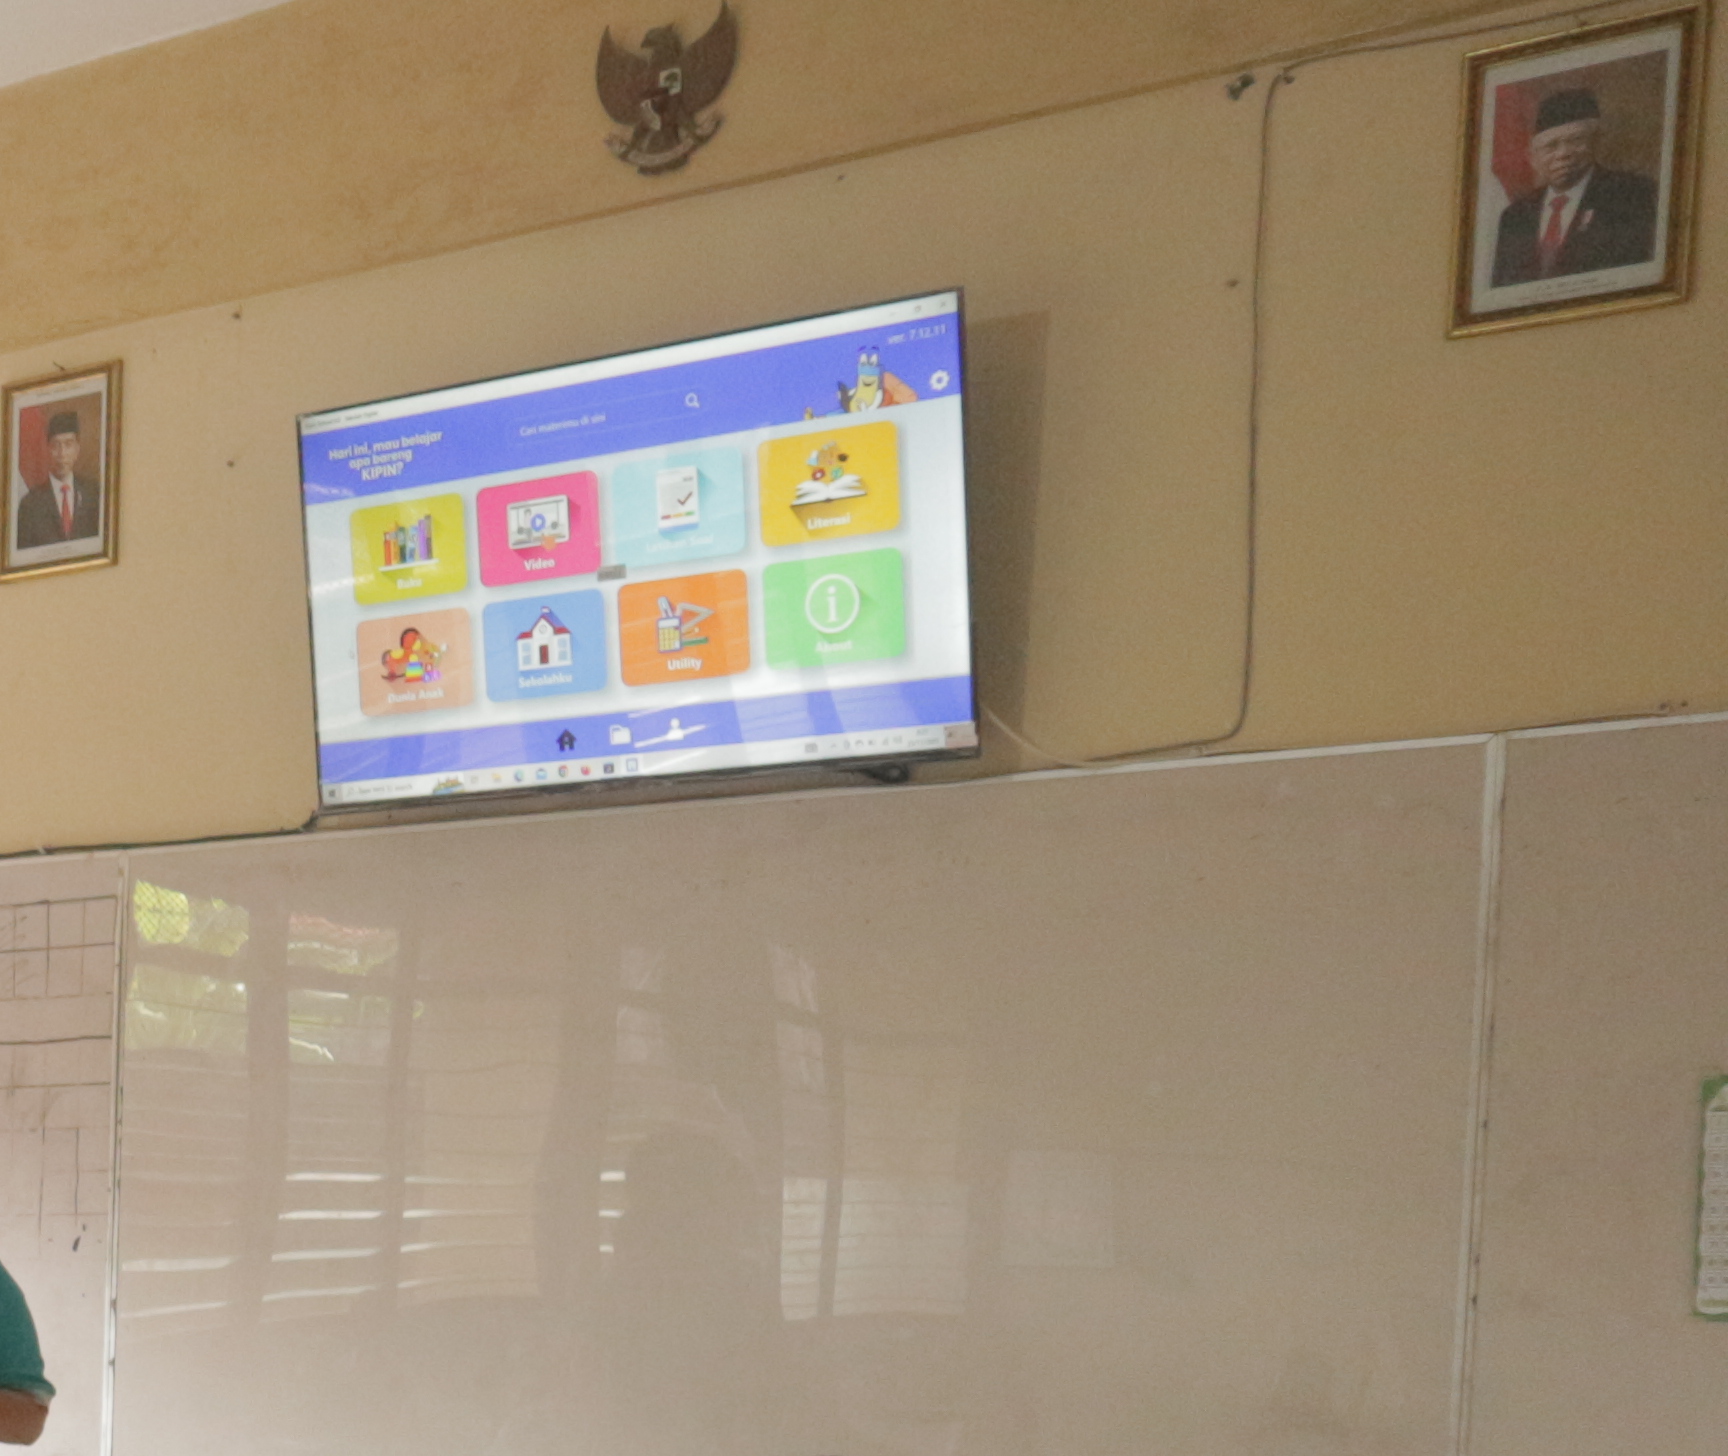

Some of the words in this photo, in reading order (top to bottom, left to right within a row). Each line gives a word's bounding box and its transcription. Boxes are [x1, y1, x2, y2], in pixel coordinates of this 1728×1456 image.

[329, 445, 353, 460] Hari
[373, 439, 400, 452] mau
[401, 430, 443, 447] belajar
[349, 457, 371, 470] apa
[372, 449, 413, 463] bareng
[361, 461, 405, 480] KIPIN?
[806, 512, 851, 530] Literasi
[523, 558, 556, 571] Video
[667, 657, 703, 672] Utility
[518, 672, 573, 688] Sekolahku
[387, 691, 416, 704] Dunia
[418, 688, 444, 700] Anak
